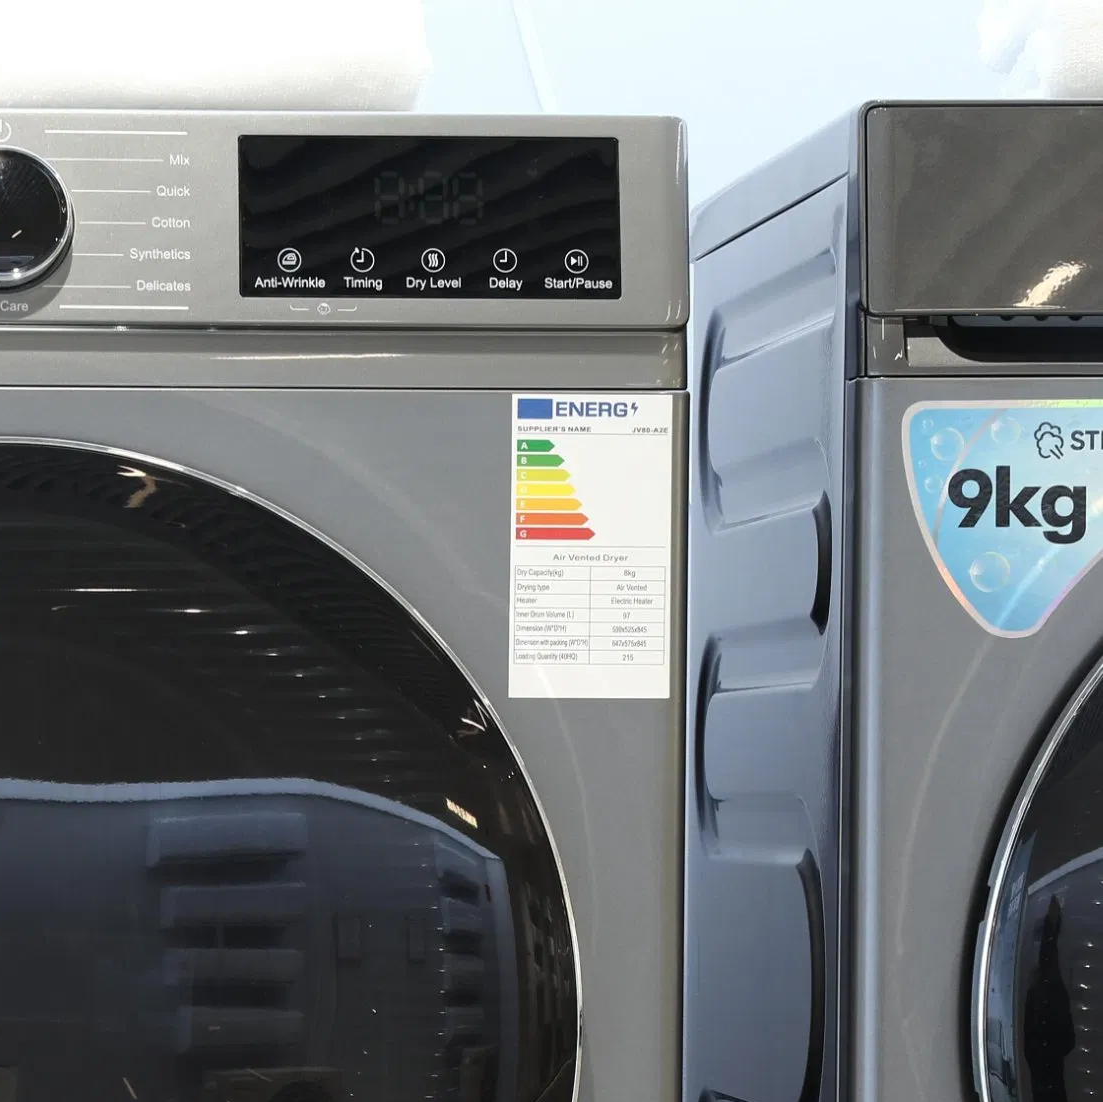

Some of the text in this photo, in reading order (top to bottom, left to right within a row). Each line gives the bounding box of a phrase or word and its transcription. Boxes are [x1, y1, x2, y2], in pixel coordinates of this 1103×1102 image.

[169, 154, 190, 166] Mix
[156, 185, 190, 198] Quick
[151, 217, 190, 229] Cotton
[129, 248, 191, 262] Synthetics
[136, 280, 191, 292] Delicates
[255, 277, 326, 289] Anti-Wrinkle
[344, 277, 383, 291] Timing
[406, 277, 461, 291] Dry Level
[489, 278, 523, 292] Delay
[544, 278, 613, 290] Start/Pause
[0, 300, 29, 312] Care
[556, 401, 628, 417] ENERG
[521, 442, 528, 450] A
[1070, 430, 1103, 451] ST
[948, 465, 1087, 545] 9kg
[520, 530, 527, 538] G
[553, 554, 629, 564] Air Vented Dryer
[623, 570, 636, 578] 8kg
[517, 584, 550, 592] Drying type
[626, 584, 648, 592] Vented
[516, 624, 544, 632] Dimension
